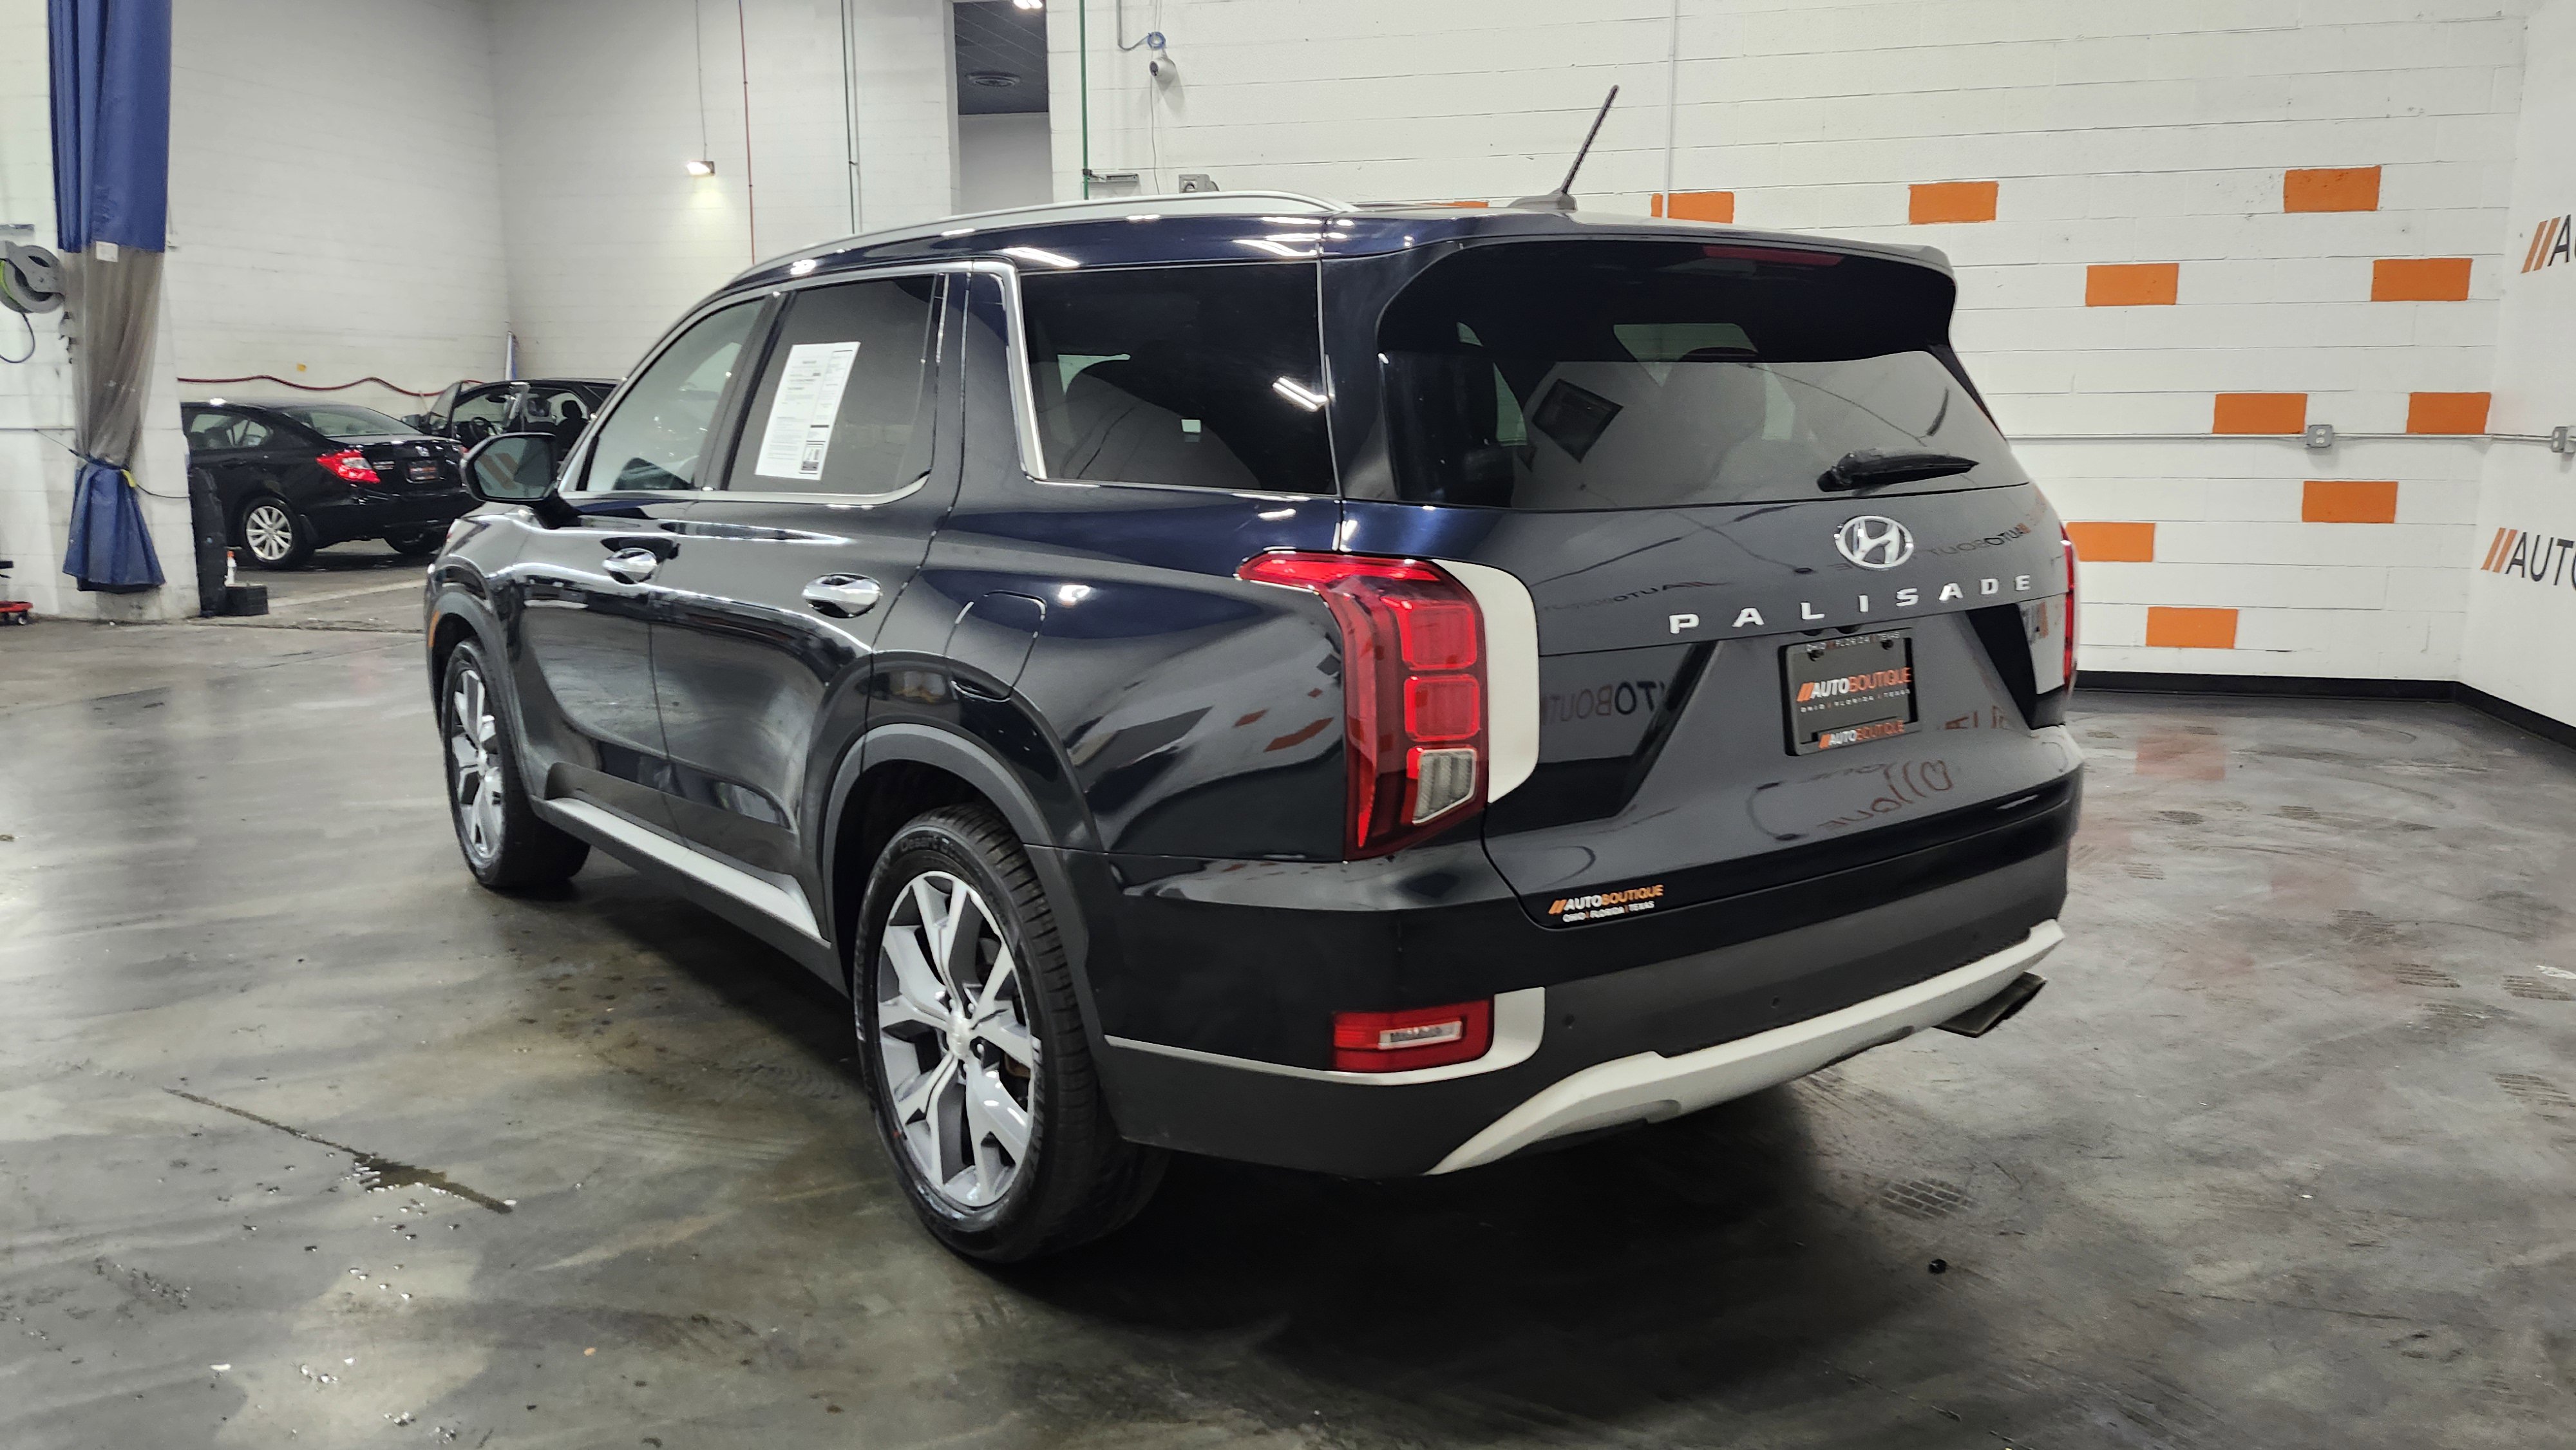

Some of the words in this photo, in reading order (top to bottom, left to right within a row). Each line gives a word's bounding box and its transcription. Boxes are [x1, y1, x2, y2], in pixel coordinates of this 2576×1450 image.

[2547, 214, 2576, 267] A
[1669, 575, 2031, 634] PALISADE
[1564, 884, 1665, 911] AUTOBOUTIQUE
